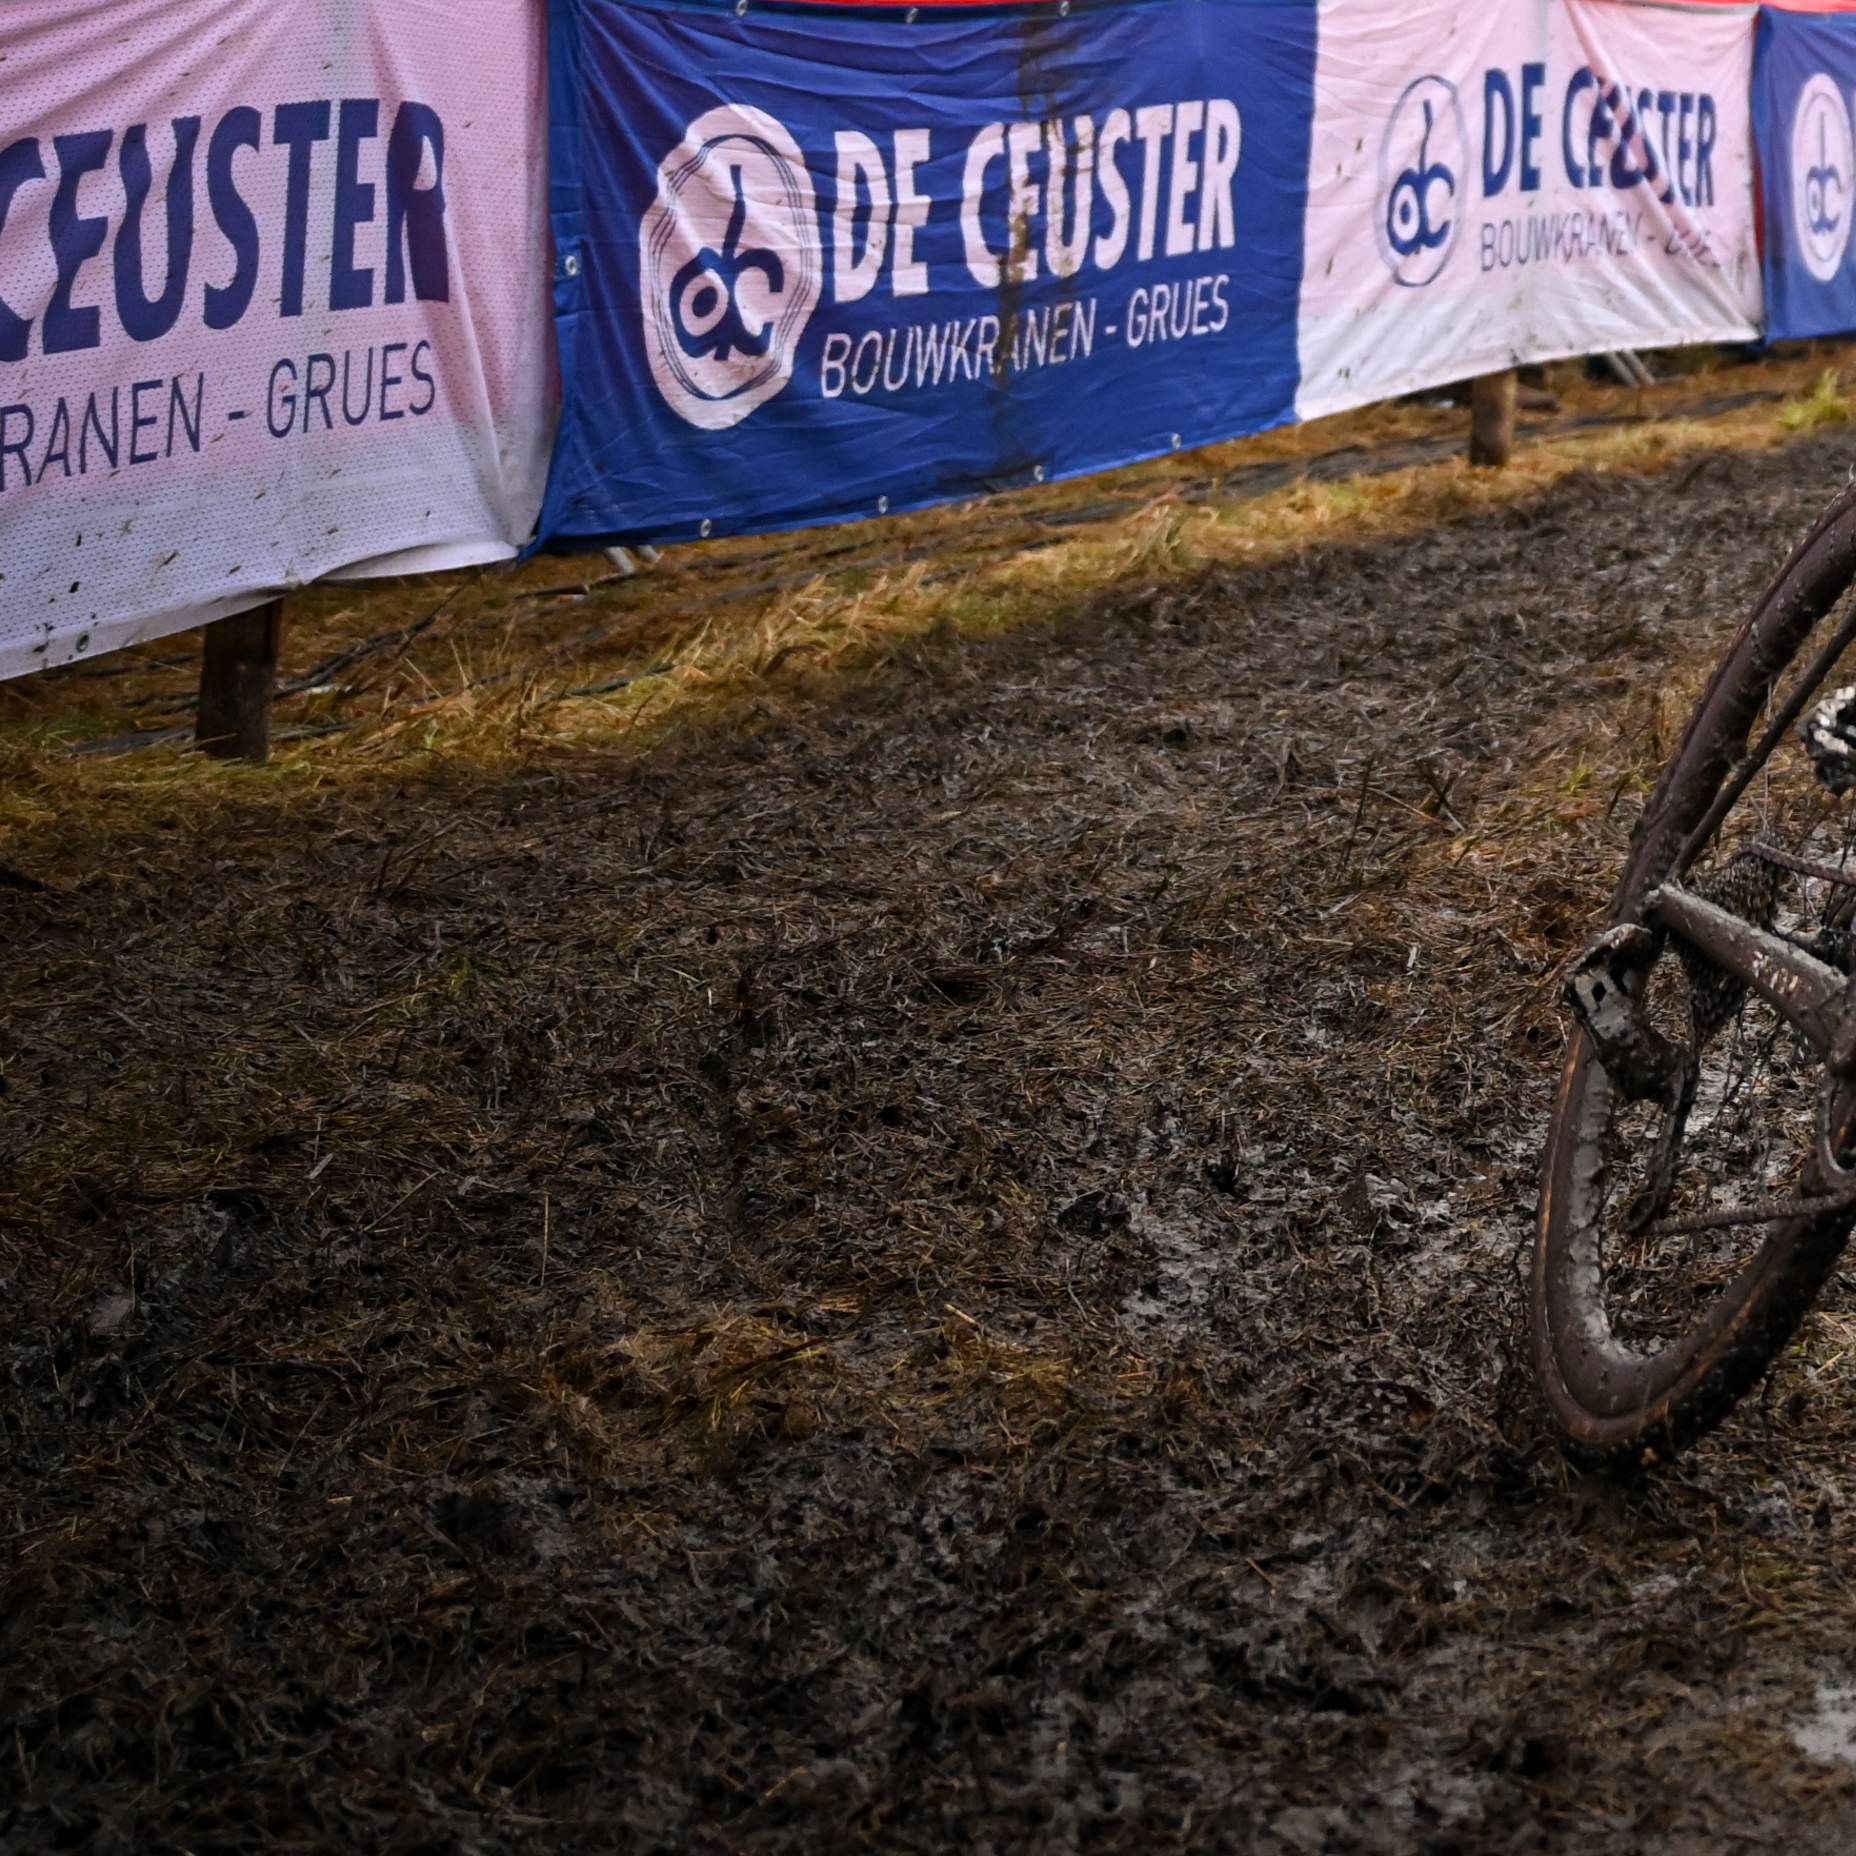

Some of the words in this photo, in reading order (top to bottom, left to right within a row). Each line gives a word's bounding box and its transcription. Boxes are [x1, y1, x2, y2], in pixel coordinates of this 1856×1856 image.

[832, 128, 931, 304] DE
[960, 98, 1243, 287] CEUSTER
[1483, 62, 1545, 199] DE
[1563, 66, 1717, 208] CEUSTER
[266, 339, 437, 438] GRUES
[820, 298, 1097, 399] BOUWKRANEN
[1126, 274, 1230, 348] GRUES
